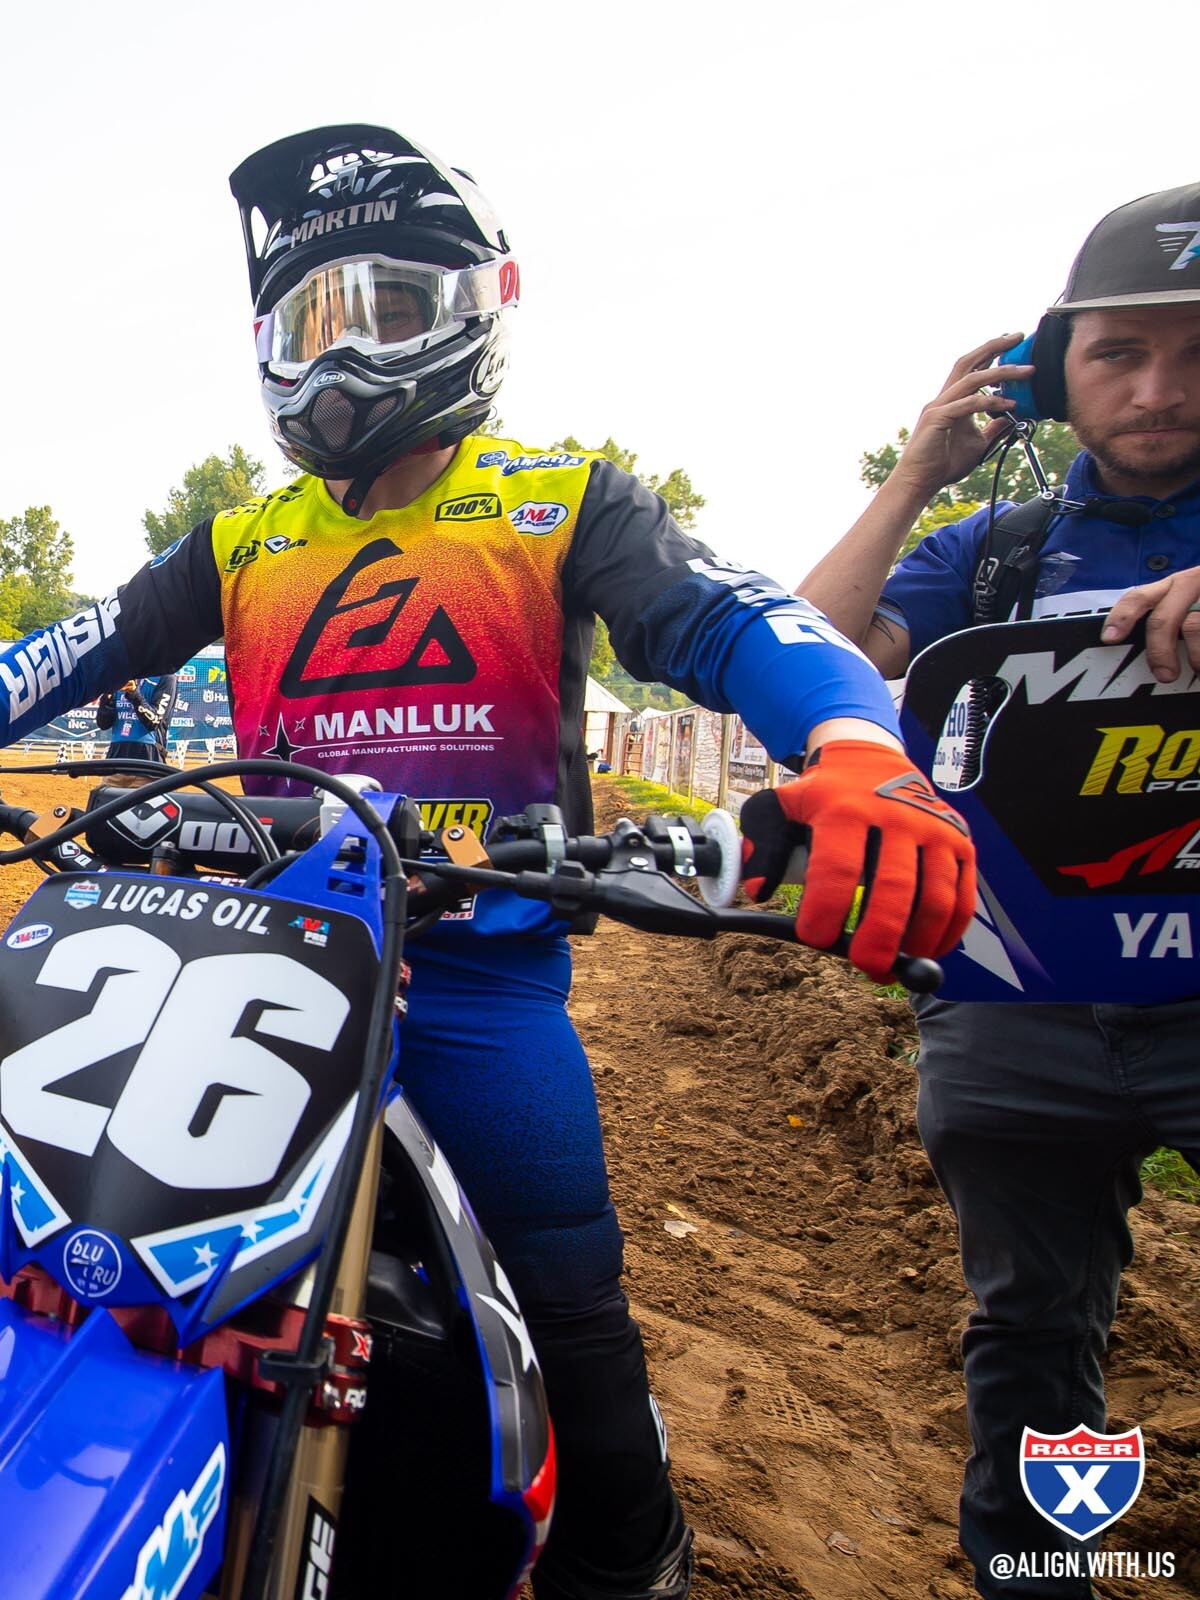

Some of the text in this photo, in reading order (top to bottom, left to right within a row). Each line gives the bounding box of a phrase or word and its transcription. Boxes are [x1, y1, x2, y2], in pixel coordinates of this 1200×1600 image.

[290, 200, 397, 248] MARTIN
[444, 497, 494, 516] 100%
[512, 507, 560, 522] AMA
[68, 720, 89, 729] INC.
[314, 704, 496, 741] MANLUK
[317, 744, 495, 759] GLOBAL MANUFACTURING SOLUTIONS
[101, 883, 271, 935] LUCAS OIL
[288, 915, 331, 933] AMA
[0, 924, 352, 1190] 26
